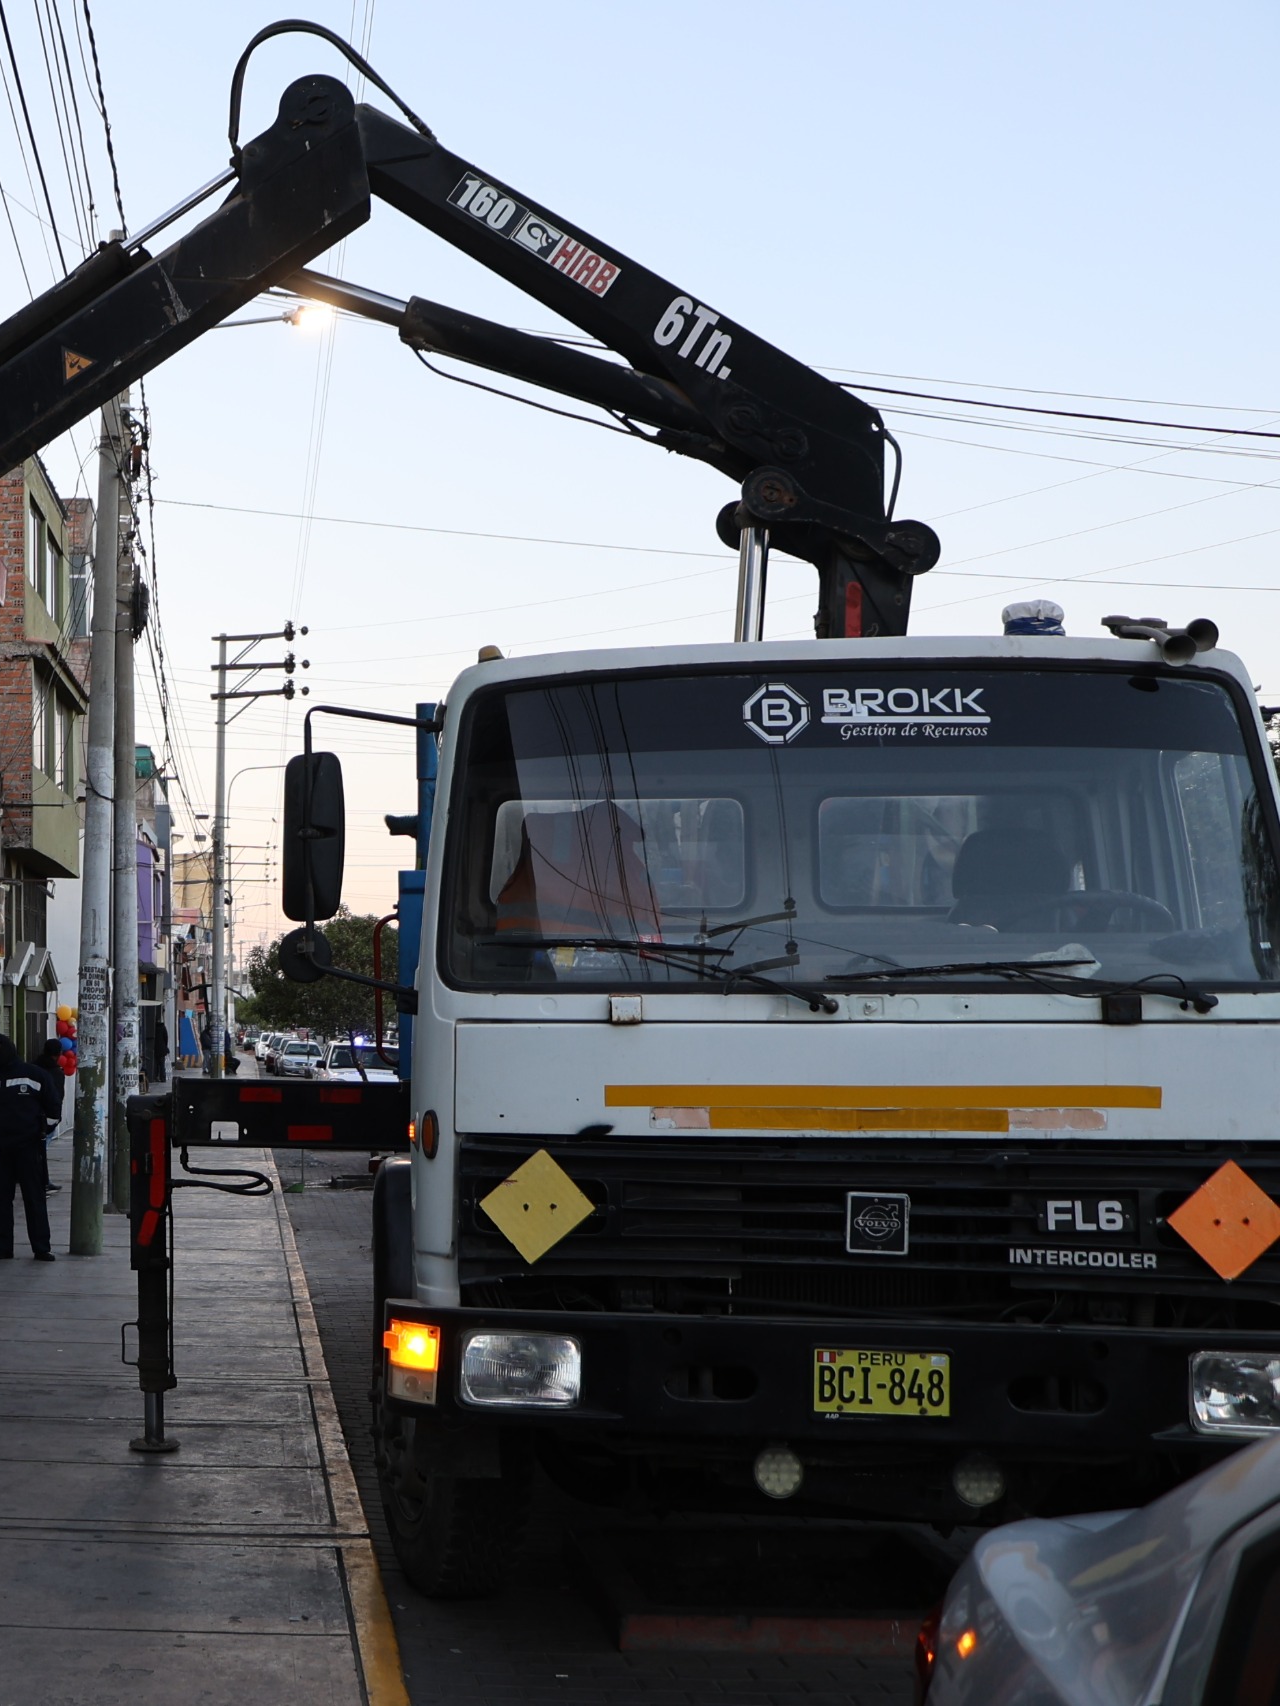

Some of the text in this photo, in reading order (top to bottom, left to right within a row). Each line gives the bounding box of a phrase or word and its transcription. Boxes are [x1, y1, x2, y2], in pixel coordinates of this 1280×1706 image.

[455, 178, 517, 231] 160
[549, 236, 618, 298] HIAB
[823, 688, 987, 714] BROKK
[840, 722, 989, 741] Gestión de Recursos
[857, 1219, 899, 1229] VOLVO
[1046, 1200, 1125, 1232] FL6
[1008, 1247, 1158, 1270] INTERCOOLER
[857, 1351, 907, 1367] PERU
[818, 1364, 945, 1408] BCI-848
